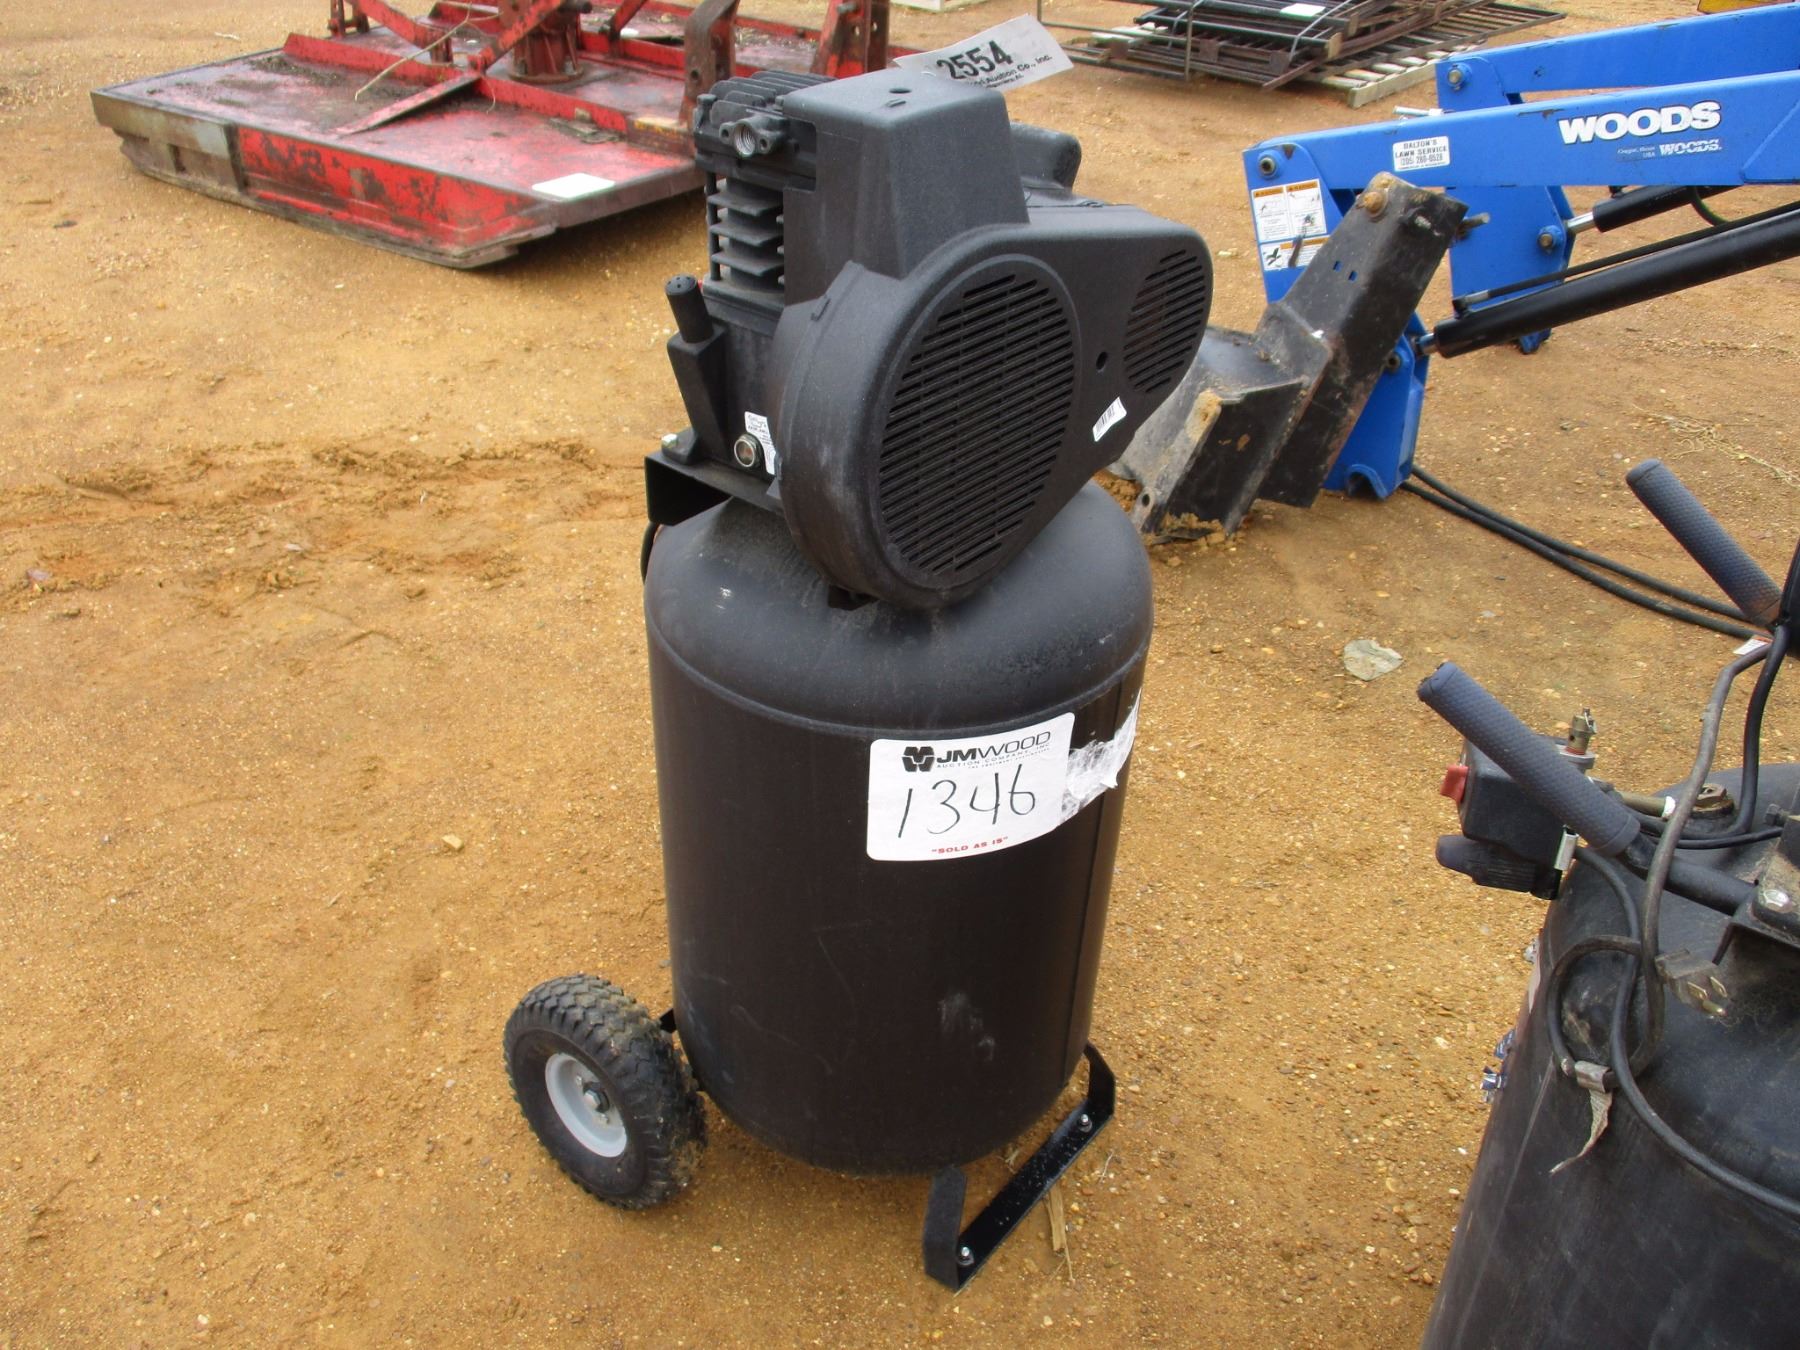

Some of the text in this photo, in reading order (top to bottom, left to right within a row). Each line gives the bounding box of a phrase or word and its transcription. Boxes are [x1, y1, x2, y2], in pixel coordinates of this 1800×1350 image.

[936, 40, 1014, 79] 2554
[1558, 101, 1722, 144] WOODS
[1395, 145, 1447, 158] LAWN SERVICE
[937, 760, 980, 768] AUCTION
[898, 764, 1036, 838] 1346
[973, 841, 988, 849] AS
